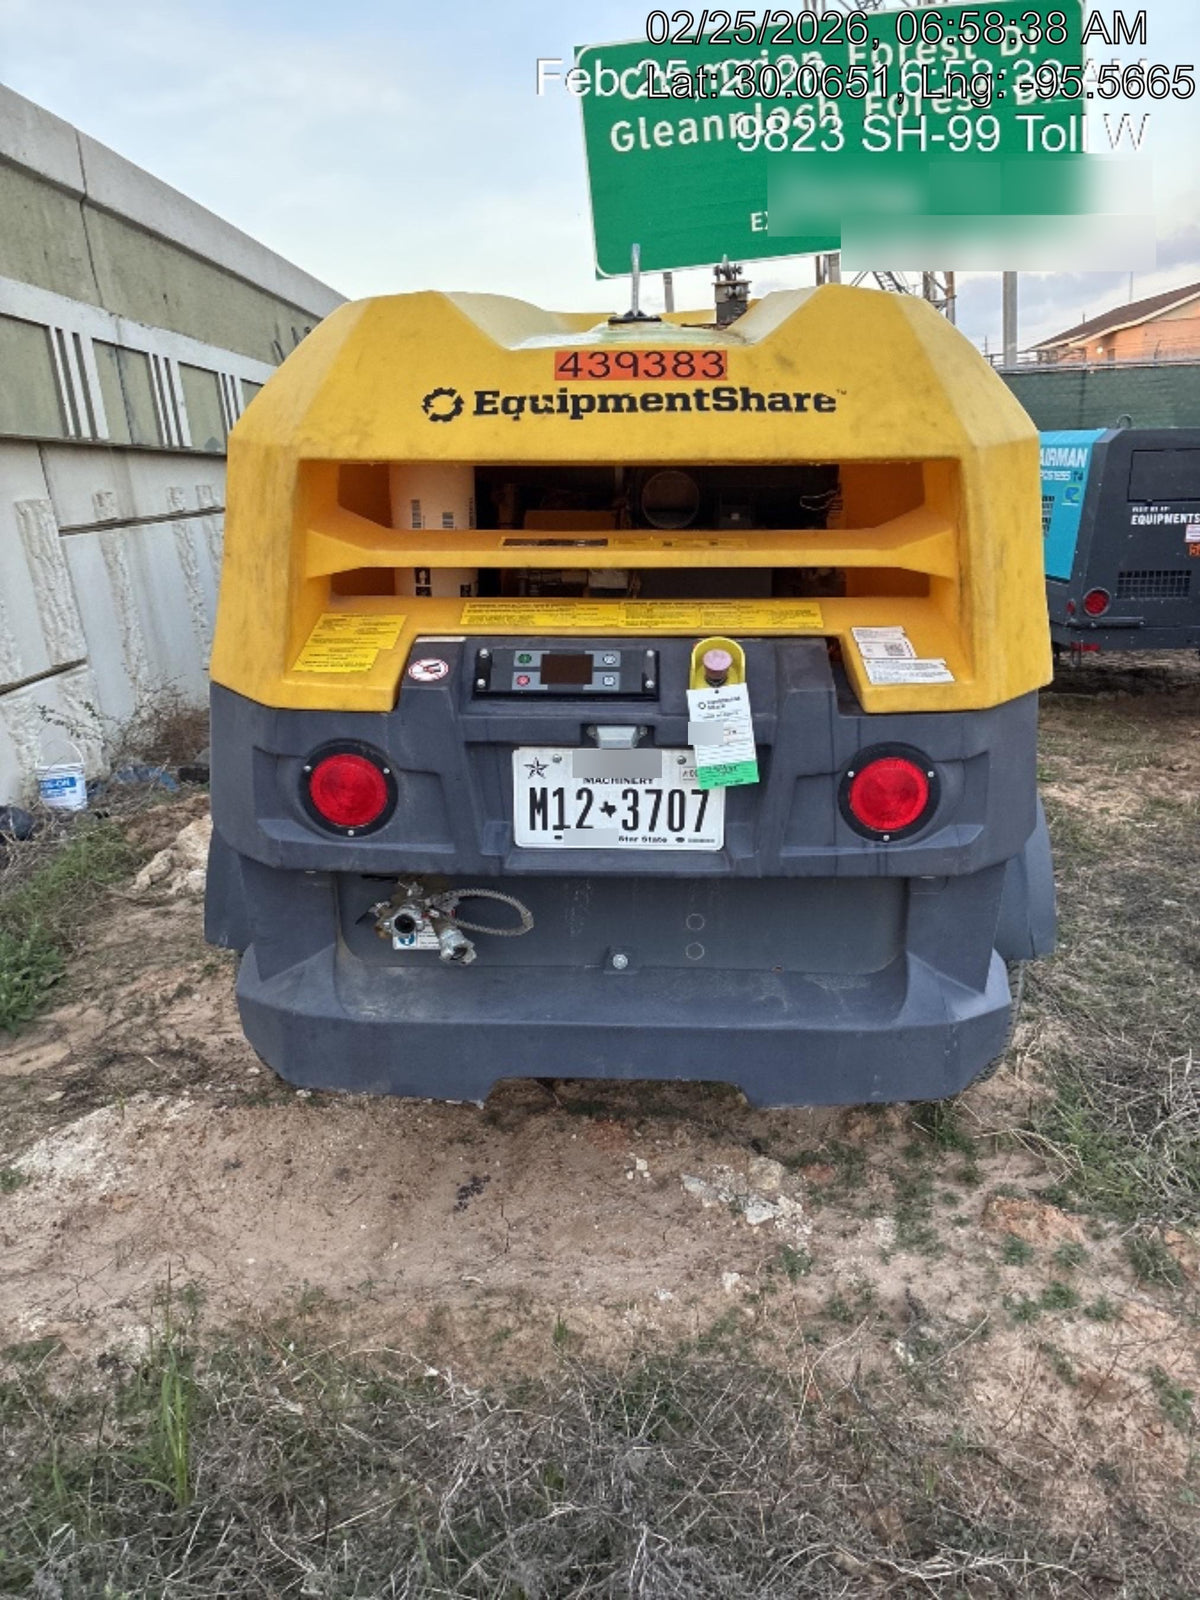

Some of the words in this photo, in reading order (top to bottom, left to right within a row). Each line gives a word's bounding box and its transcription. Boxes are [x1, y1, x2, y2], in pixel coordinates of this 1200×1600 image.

[557, 350, 727, 379] 439383
[473, 386, 838, 421] EquipmentShare
[529, 786, 594, 831] M12
[621, 788, 711, 832] 3707
